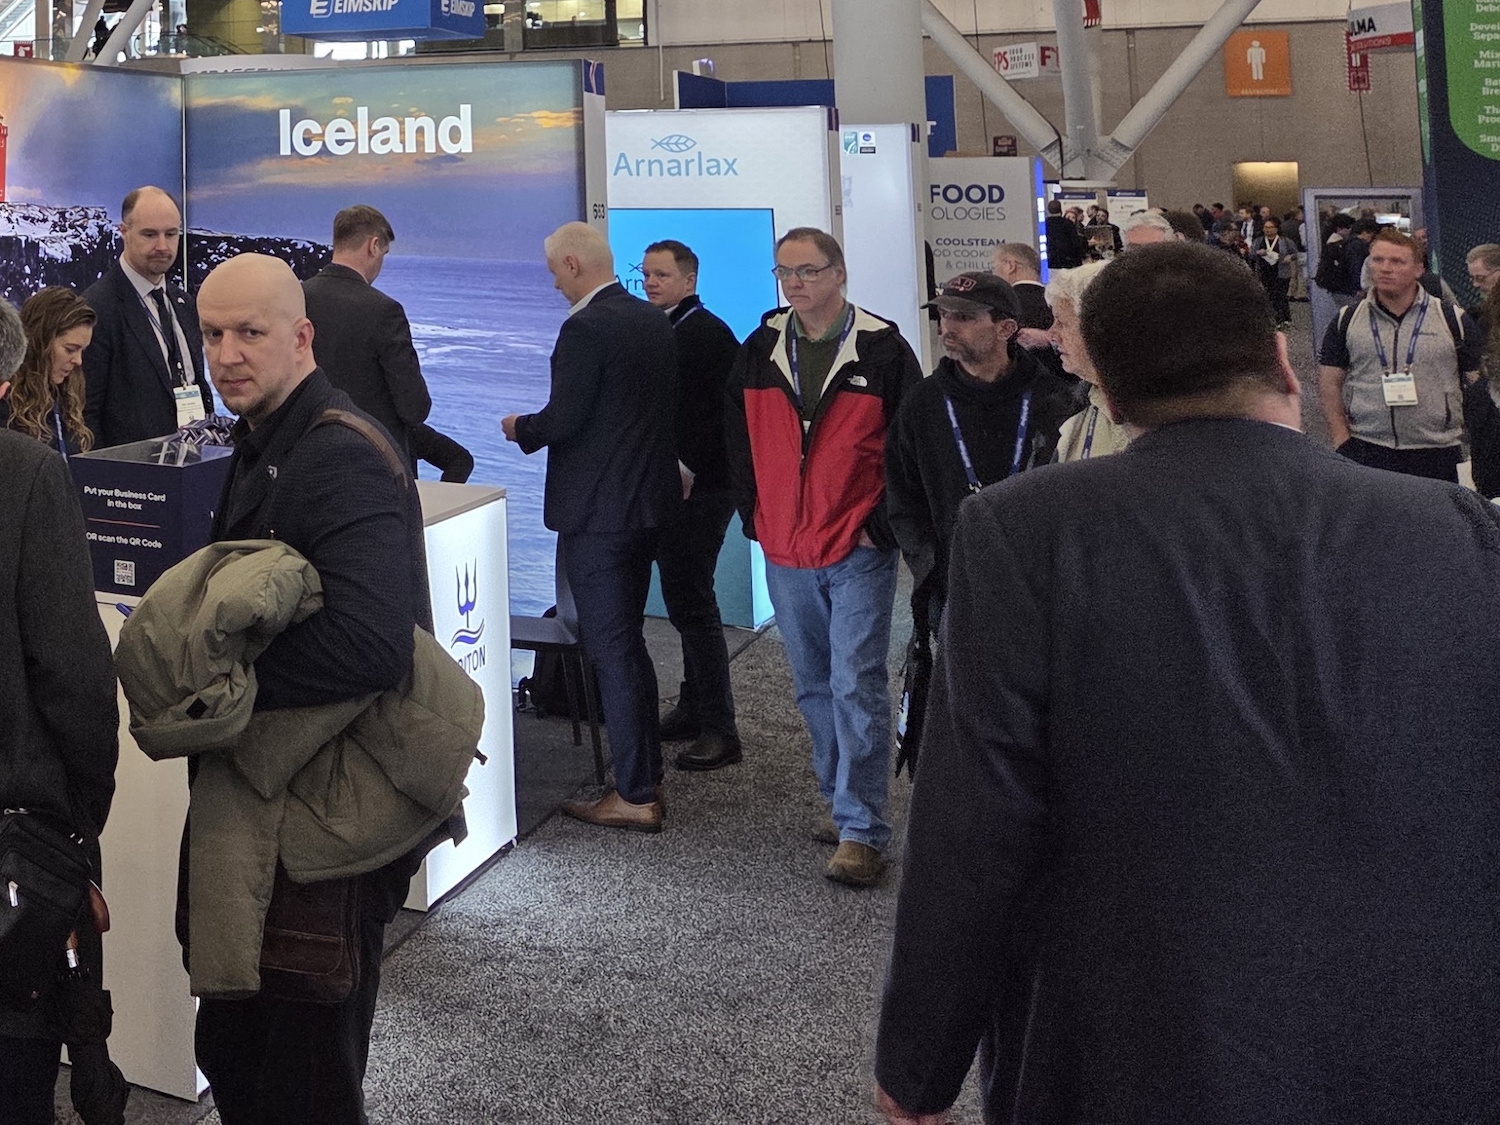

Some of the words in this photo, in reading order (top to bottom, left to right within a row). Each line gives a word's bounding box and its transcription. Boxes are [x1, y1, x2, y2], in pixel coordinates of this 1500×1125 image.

[451, 0, 476, 17] EIMSKIP
[279, 104, 473, 156] Iceland
[613, 151, 739, 176] Arnarlax
[931, 184, 1005, 204] FOOD
[931, 206, 1006, 221] OLOGIES
[936, 238, 1006, 246] COOLSTEAM
[954, 249, 990, 258] COOK
[84, 485, 97, 495] Put
[114, 489, 147, 500] Business
[147, 492, 166, 502] Card
[115, 500, 127, 508] the
[128, 501, 142, 510] box
[86, 532, 97, 540] OR
[98, 535, 115, 543] scan
[116, 535, 129, 544] the
[129, 537, 141, 546] QR
[141, 538, 162, 549] Code
